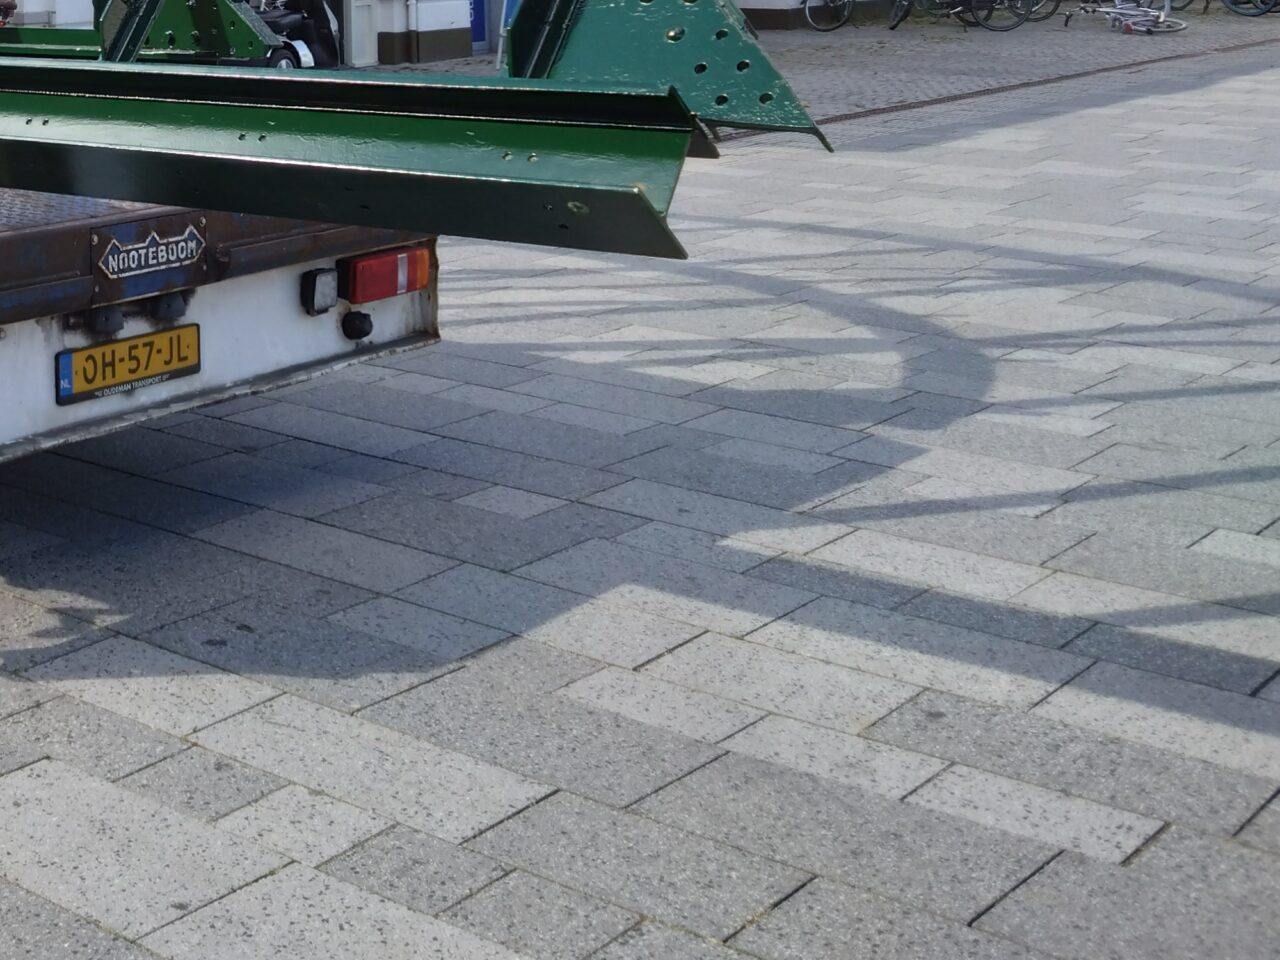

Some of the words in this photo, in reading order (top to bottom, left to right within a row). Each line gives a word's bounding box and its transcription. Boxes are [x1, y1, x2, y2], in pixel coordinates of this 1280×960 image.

[108, 240, 197, 273] NOOTEBOOM
[83, 335, 188, 384] OH-57-JL
[60, 378, 71, 390] NL
[131, 375, 162, 389] TRANSPORT
